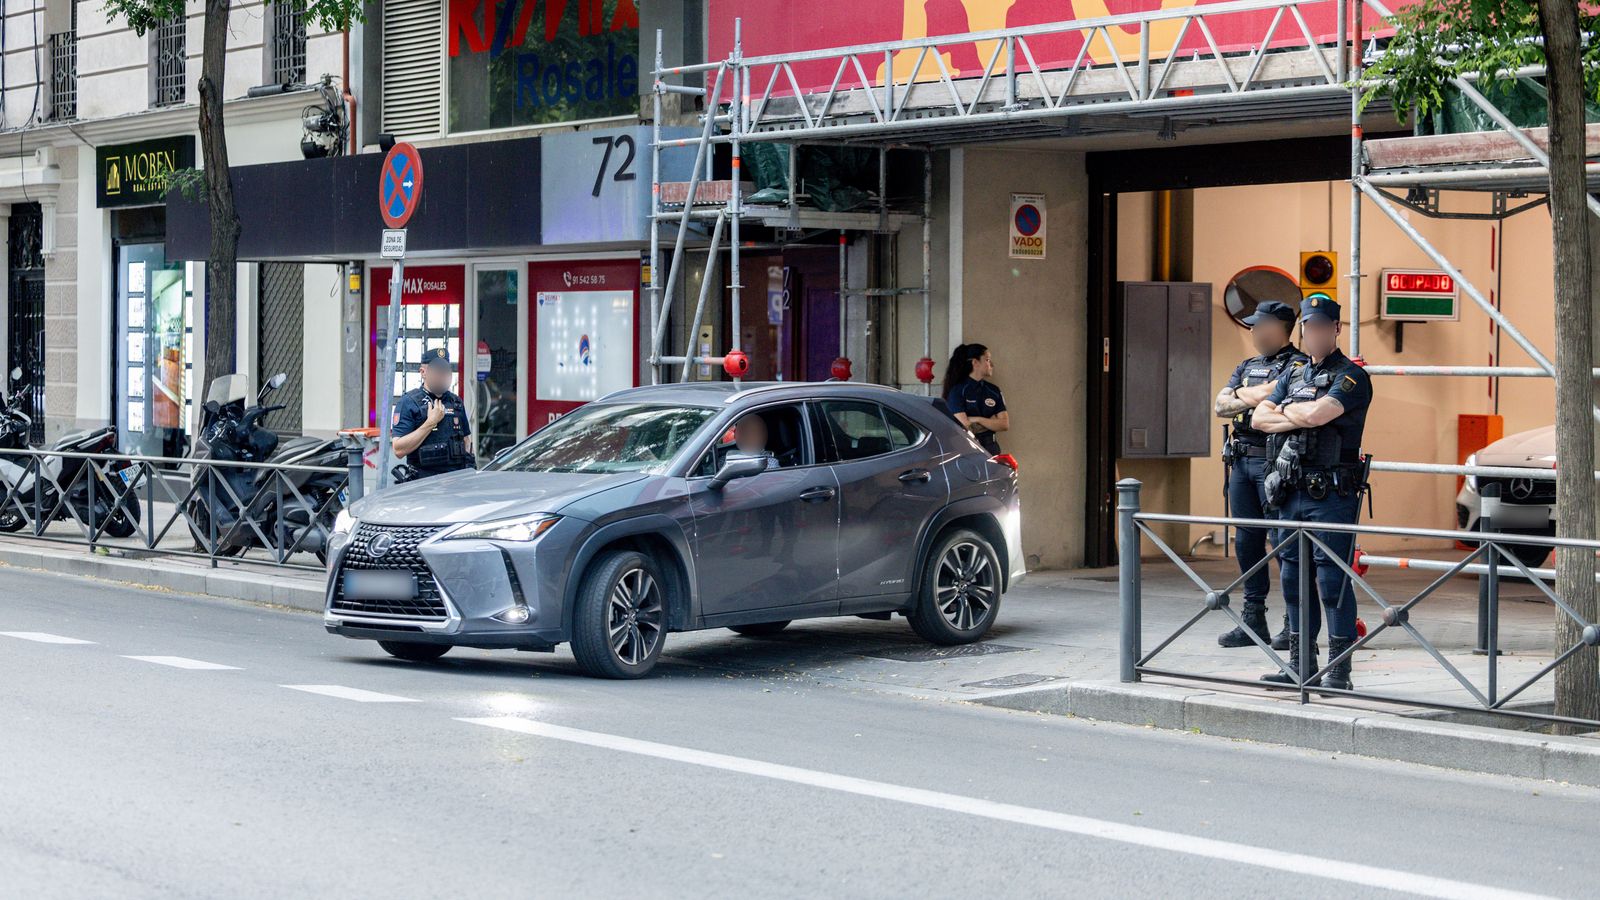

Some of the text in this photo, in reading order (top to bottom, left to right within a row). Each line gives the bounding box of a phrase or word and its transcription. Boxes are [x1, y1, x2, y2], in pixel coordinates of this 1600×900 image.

[125, 150, 175, 182] MOBEN
[592, 134, 636, 198] 72
[1013, 237, 1042, 247] VADO
[423, 281, 447, 290] ROSALES
[572, 275, 578, 284] 91
[579, 275, 590, 284] 542
[598, 275, 606, 284] 75
[1391, 275, 1450, 290] OCUPADO
